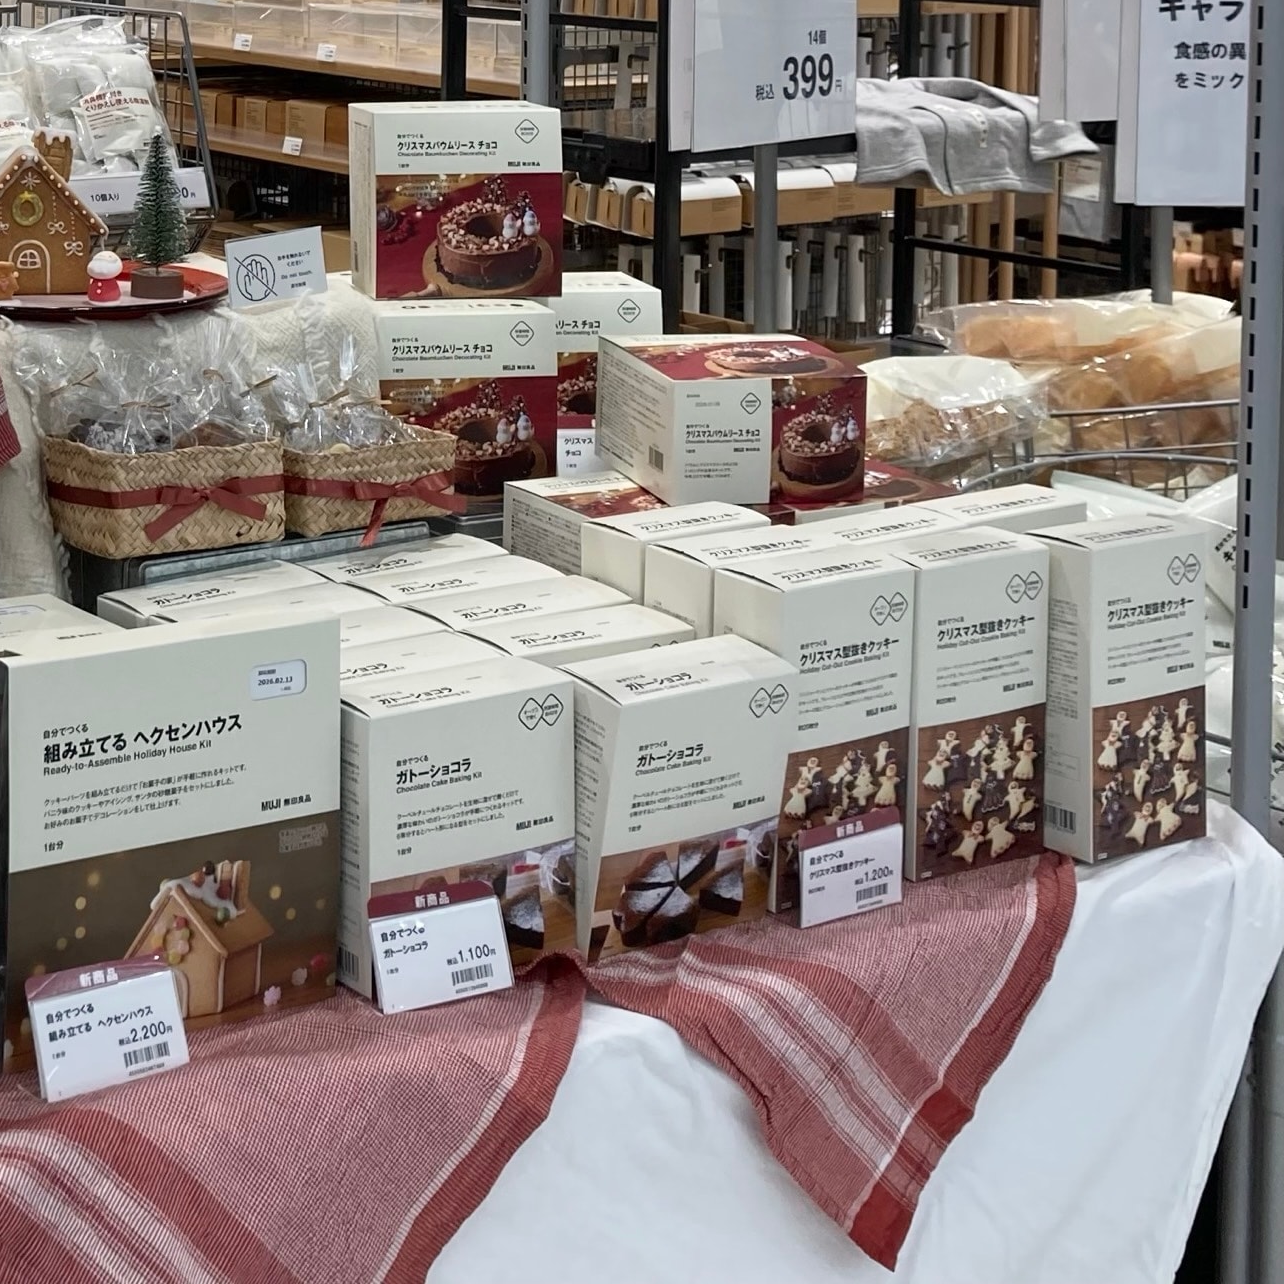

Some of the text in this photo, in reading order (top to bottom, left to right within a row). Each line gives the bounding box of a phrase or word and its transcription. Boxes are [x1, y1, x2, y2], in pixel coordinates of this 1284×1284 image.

[397, 140, 498, 150] クリスマスバウムリース チョコ
[392, 343, 493, 354] クリスマスバウムリース チョコ
[1107, 597, 1195, 622] クリスマス型抜きクッキー
[937, 615, 1035, 642] クリスマス型抜きクッキー
[799, 637, 900, 667] クリスマス型抜きクッキー
[625, 672, 692, 691] ガトーショコラ
[378, 686, 453, 706] ガトーショコラ
[43, 722, 89, 740] 自分でつくる
[44, 714, 242, 764] 組み立てる ヘクセンハウス
[43, 738, 212, 776] Ready-to-Assemble Holiday House Kit
[396, 754, 429, 766] 自分でつくる
[637, 743, 704, 768] ガトーショコラ
[396, 757, 471, 786] ガトーショコラ
[635, 766, 666, 777] Chocolate
[682, 758, 702, 769] Baking
[396, 771, 482, 794] Chocolate Cake Baking Kit
[261, 793, 312, 812] MUJI 無印良品
[810, 850, 844, 866] 自分でつくる
[809, 857, 876, 880] クリスマス型抜きクッキー
[414, 891, 450, 909] 新商品
[381, 927, 425, 942] 自分でつくる
[383, 941, 429, 959] ガトーショコラ
[79, 968, 119, 987] 新商品
[46, 1003, 95, 1025] 自分でつくる
[49, 1006, 154, 1043] 組み立てる ヘクセンハウス
